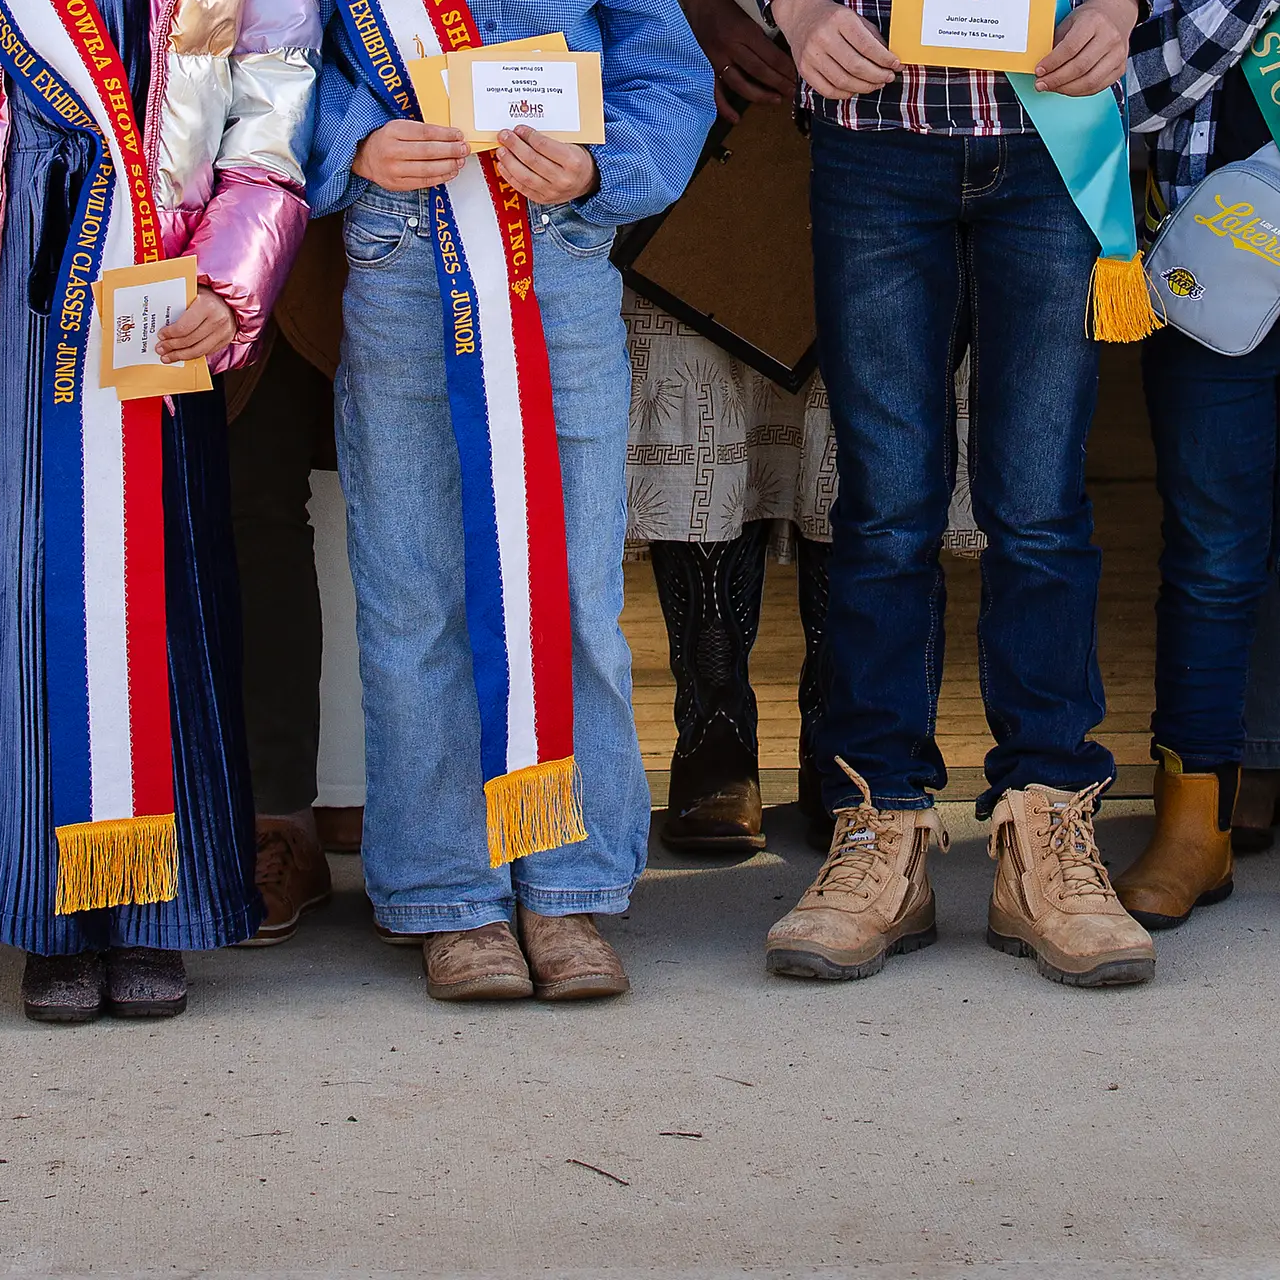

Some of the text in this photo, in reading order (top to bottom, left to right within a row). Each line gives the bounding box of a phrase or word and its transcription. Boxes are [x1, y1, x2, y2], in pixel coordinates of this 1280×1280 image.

[104, 77, 139, 154] SHOW
[509, 102, 543, 114] SHOW
[521, 86, 545, 94] Entries
[77, 164, 113, 249] PAVILION
[393, 93, 411, 110] IN
[434, 195, 461, 274] CLASSES
[450, 290, 475, 356] JUNIOR
[1260, 219, 1273, 230] LOS
[507, 219, 527, 274] INC.
[61, 252, 92, 332] CLASSES
[54, 342, 78, 404] JUNIOR
